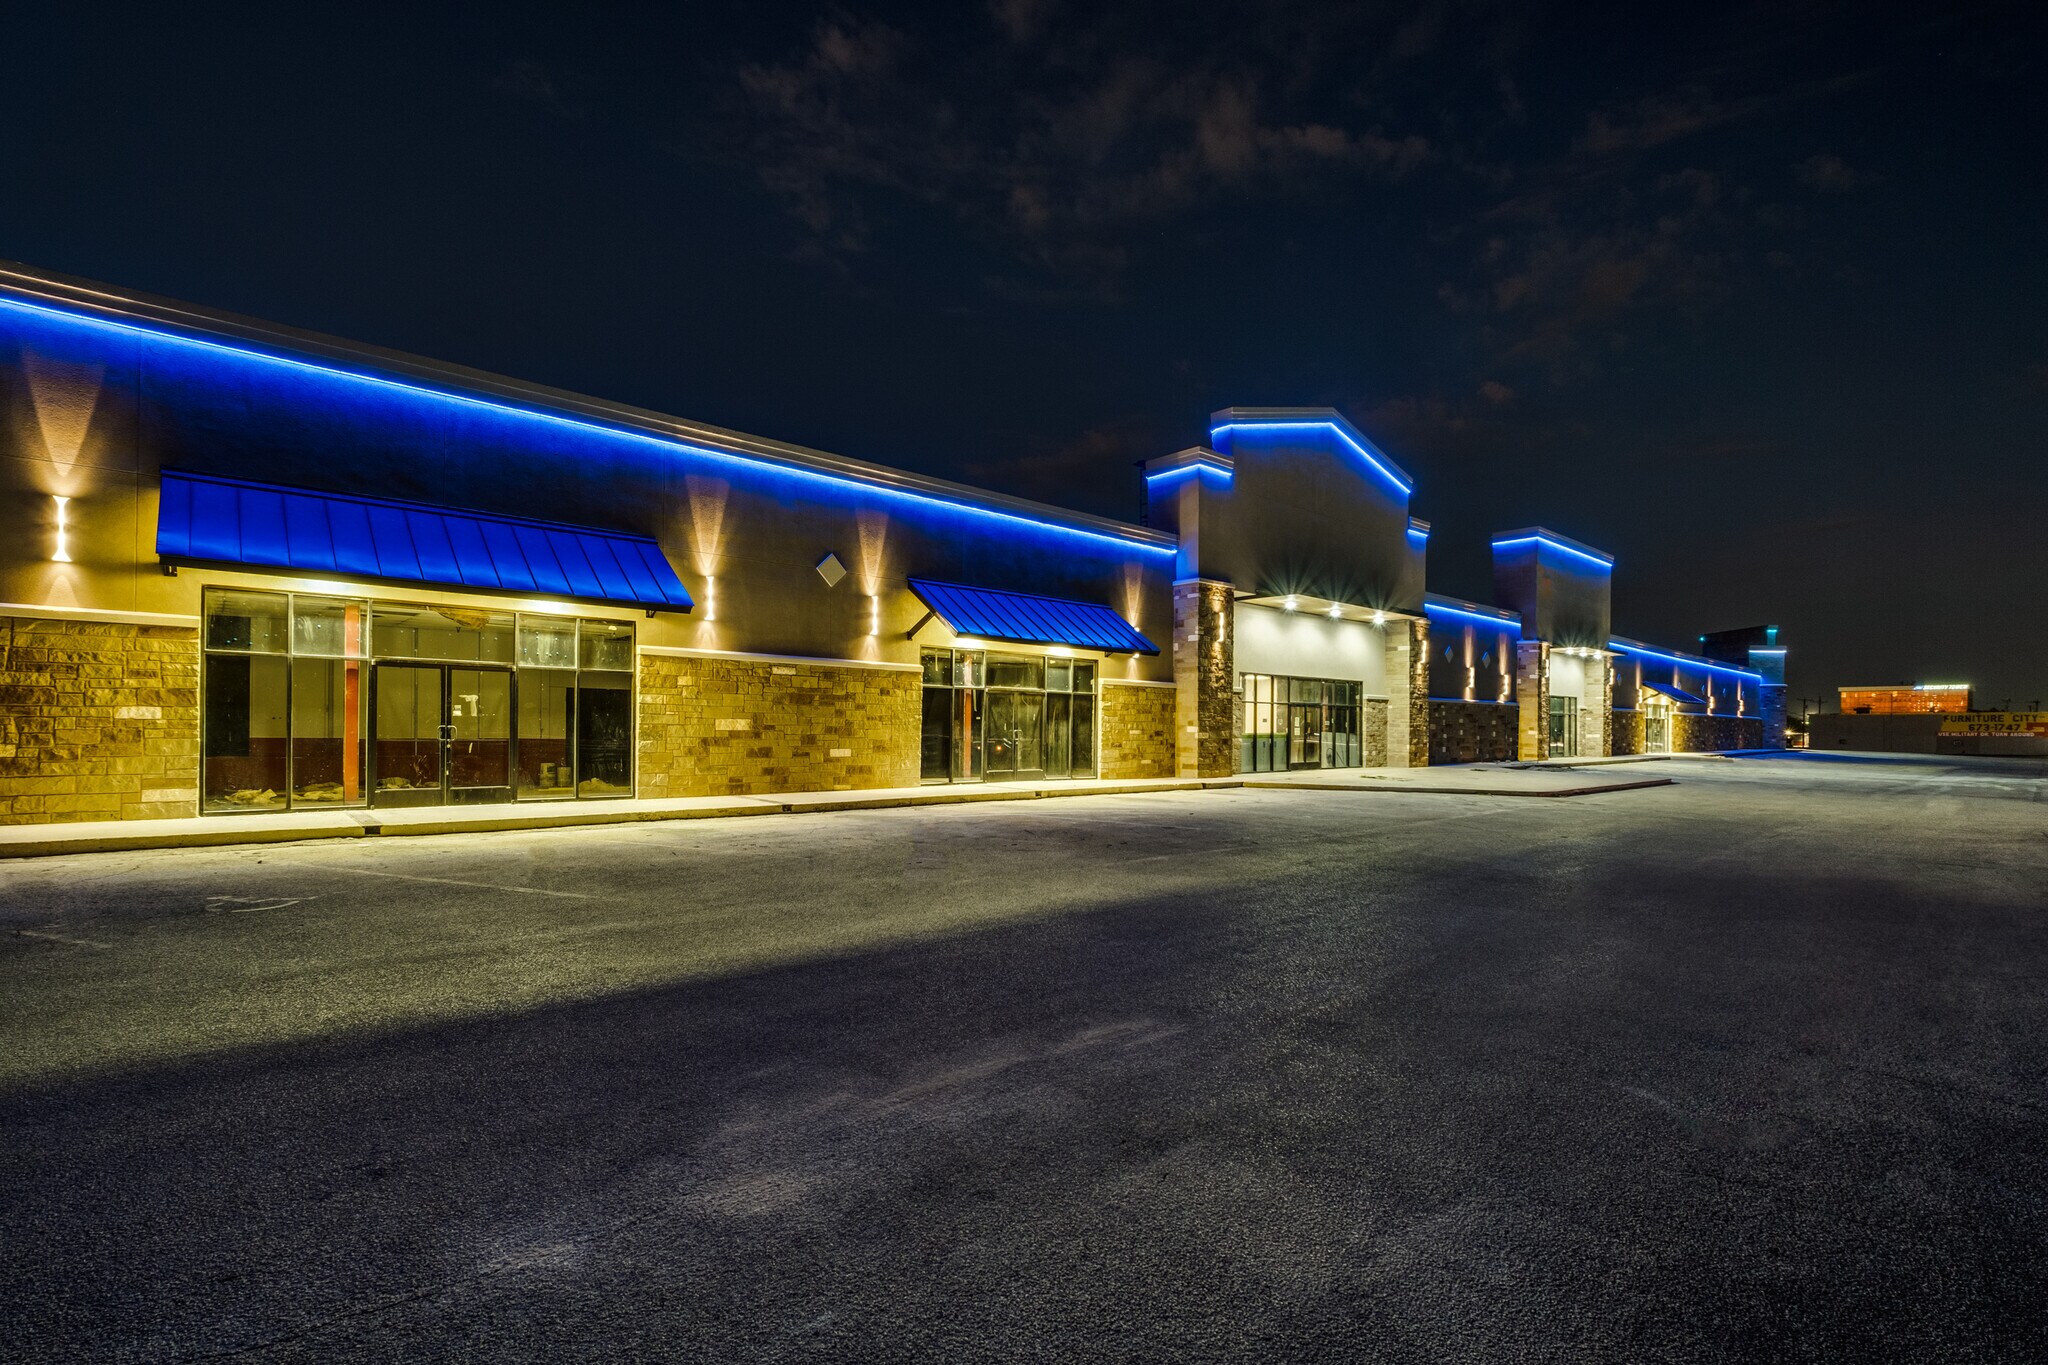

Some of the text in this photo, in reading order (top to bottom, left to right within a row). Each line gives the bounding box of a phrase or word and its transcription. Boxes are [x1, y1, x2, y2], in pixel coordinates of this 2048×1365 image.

[1943, 714, 2038, 723] FURNITURE CITY
[1968, 723, 2021, 732] 673-1747
